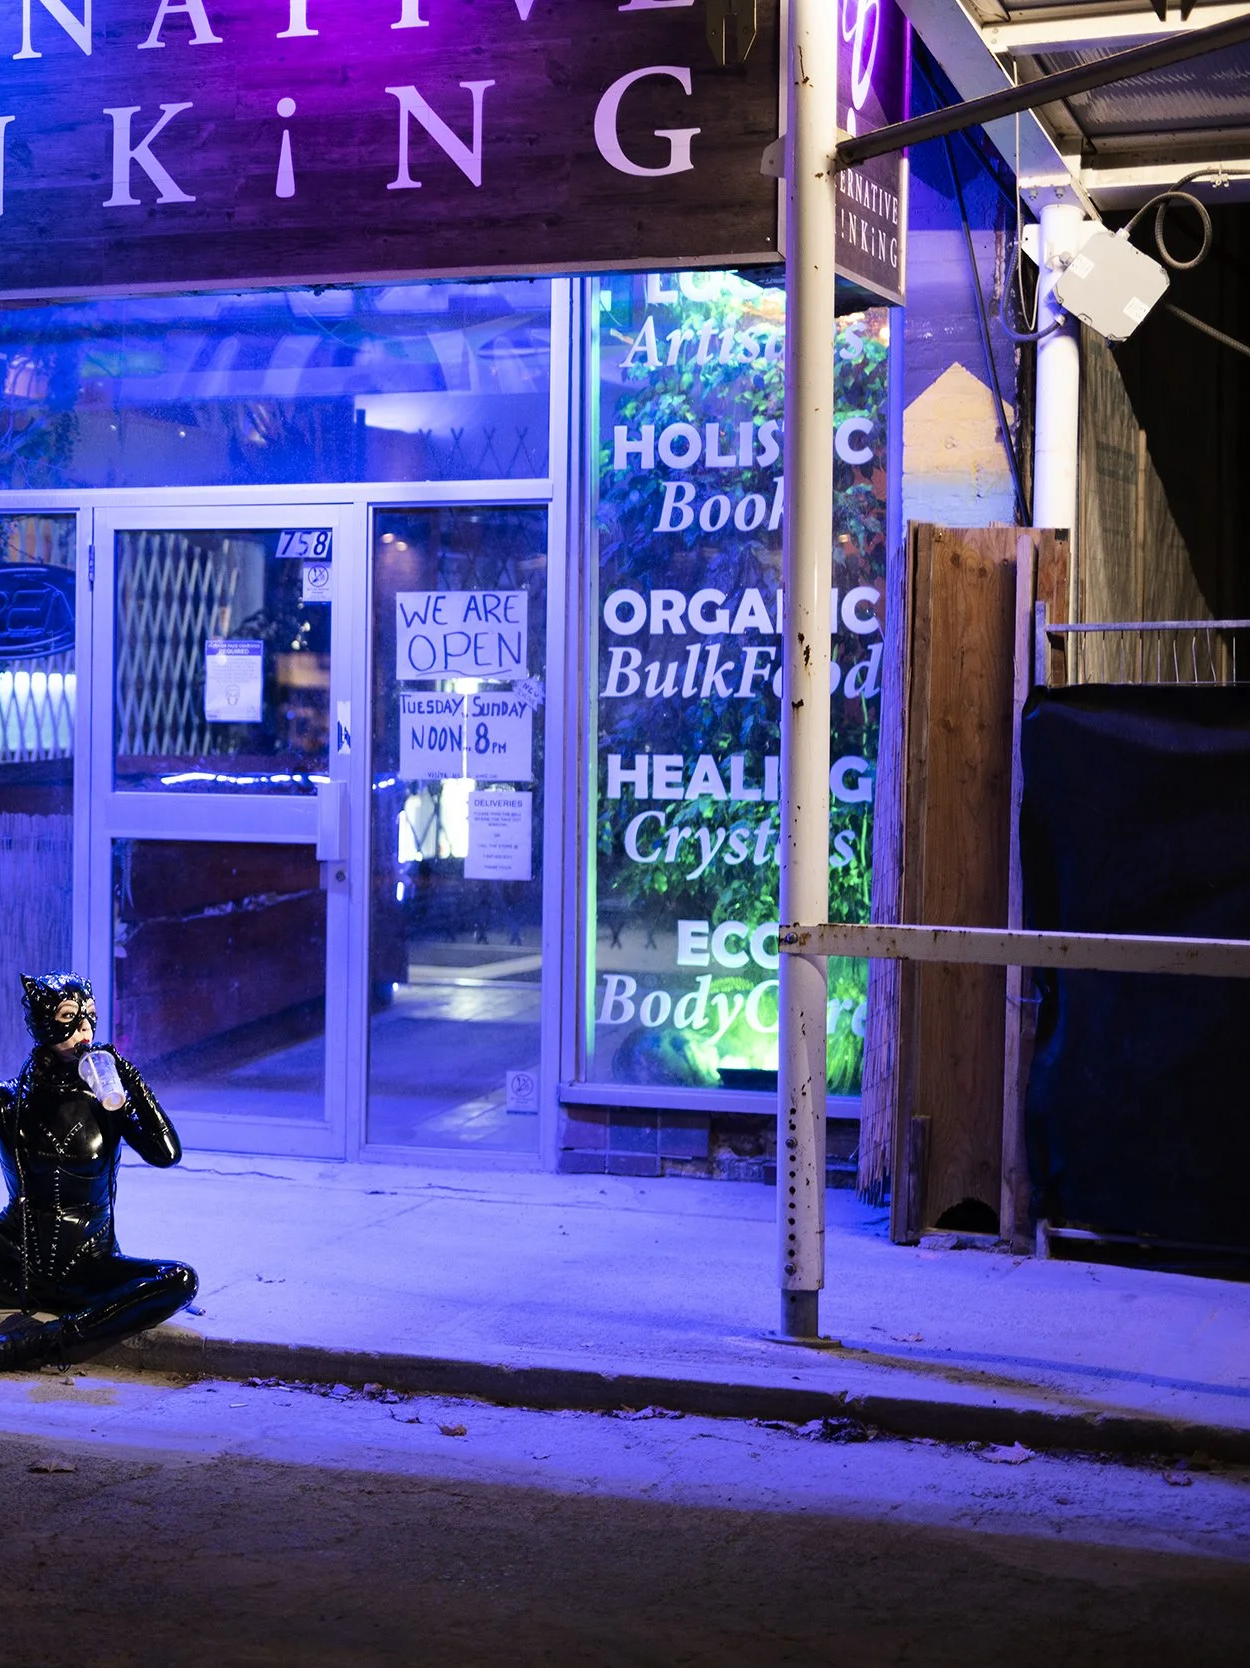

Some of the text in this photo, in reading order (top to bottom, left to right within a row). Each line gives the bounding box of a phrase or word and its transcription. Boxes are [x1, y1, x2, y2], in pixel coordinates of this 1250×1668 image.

[618, 313, 867, 368] Artisas
[612, 417, 875, 470] HOLISC
[281, 531, 328, 556] 758
[400, 594, 520, 628] WE ARE
[603, 585, 881, 636] ORGAIC
[408, 631, 521, 671] OPEN
[400, 694, 466, 717] TUESDAY
[411, 724, 463, 753] NOON
[607, 754, 873, 804] HEALIG
[473, 799, 524, 808] DELIVERIES
[624, 810, 856, 880] Crysts
